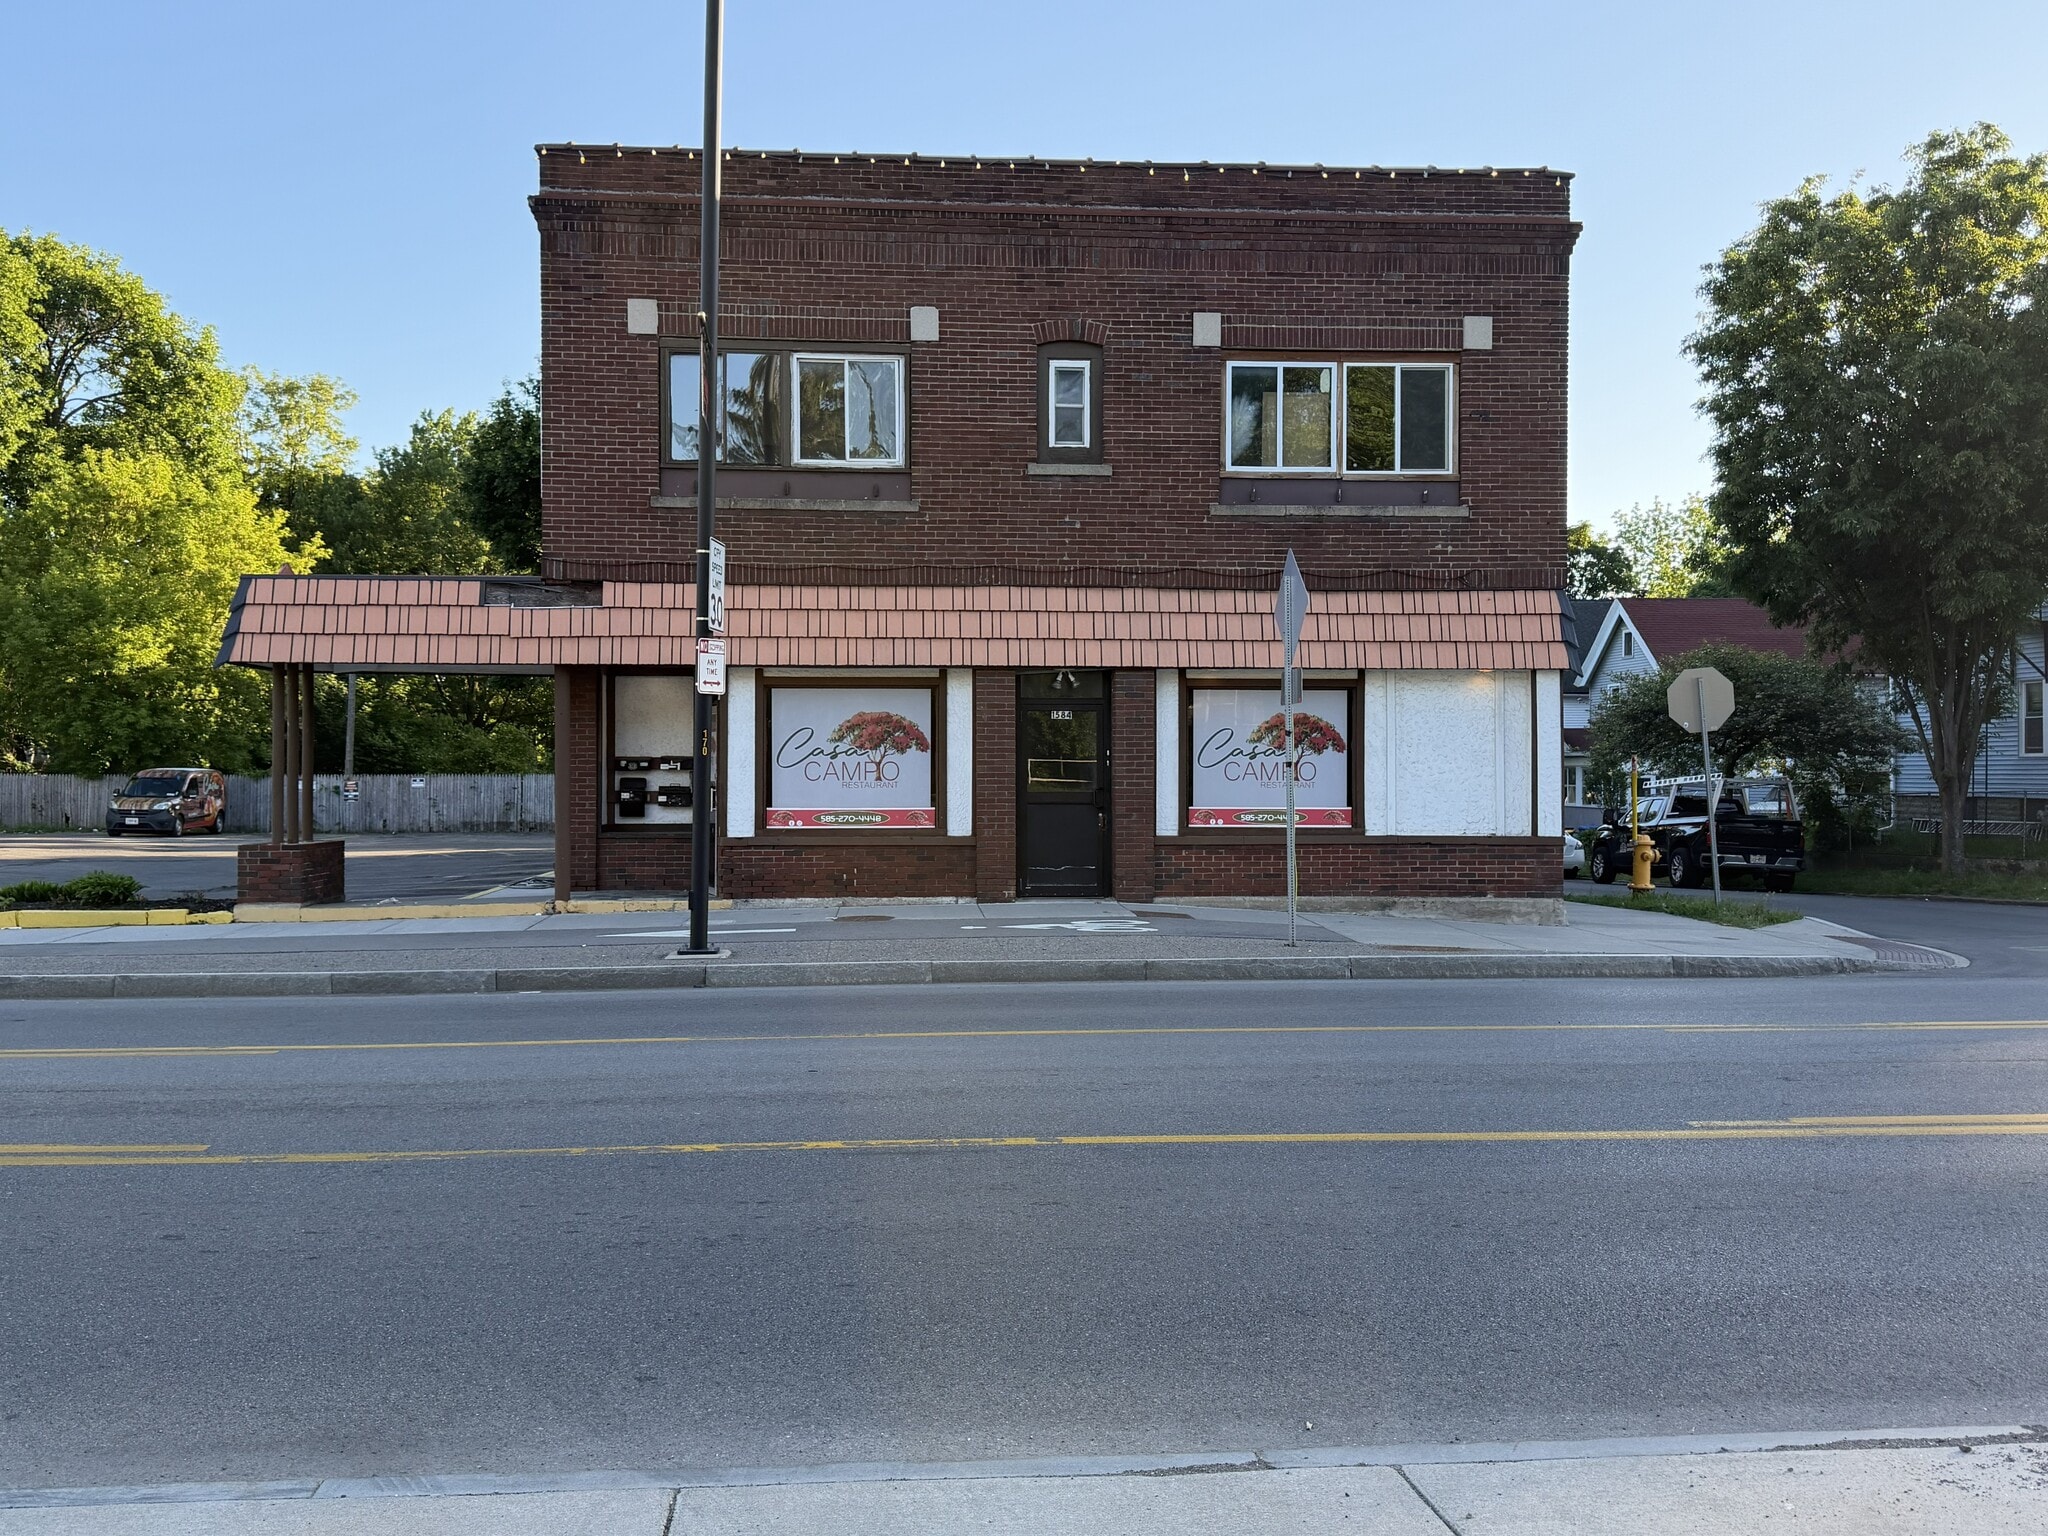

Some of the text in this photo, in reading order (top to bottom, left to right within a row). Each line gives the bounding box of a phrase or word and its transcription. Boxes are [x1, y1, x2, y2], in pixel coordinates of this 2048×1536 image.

[710, 593, 723, 628] 30
[1052, 711, 1072, 719] 1584
[776, 727, 869, 769] Casa
[1197, 727, 1287, 769] Casa
[804, 761, 900, 782] CAMPO
[841, 781, 899, 789] RESTAURANT
[1260, 781, 1316, 789] RESTARANT
[820, 815, 882, 823] 585-270-4448
[1240, 814, 1300, 822] 585-270-448
